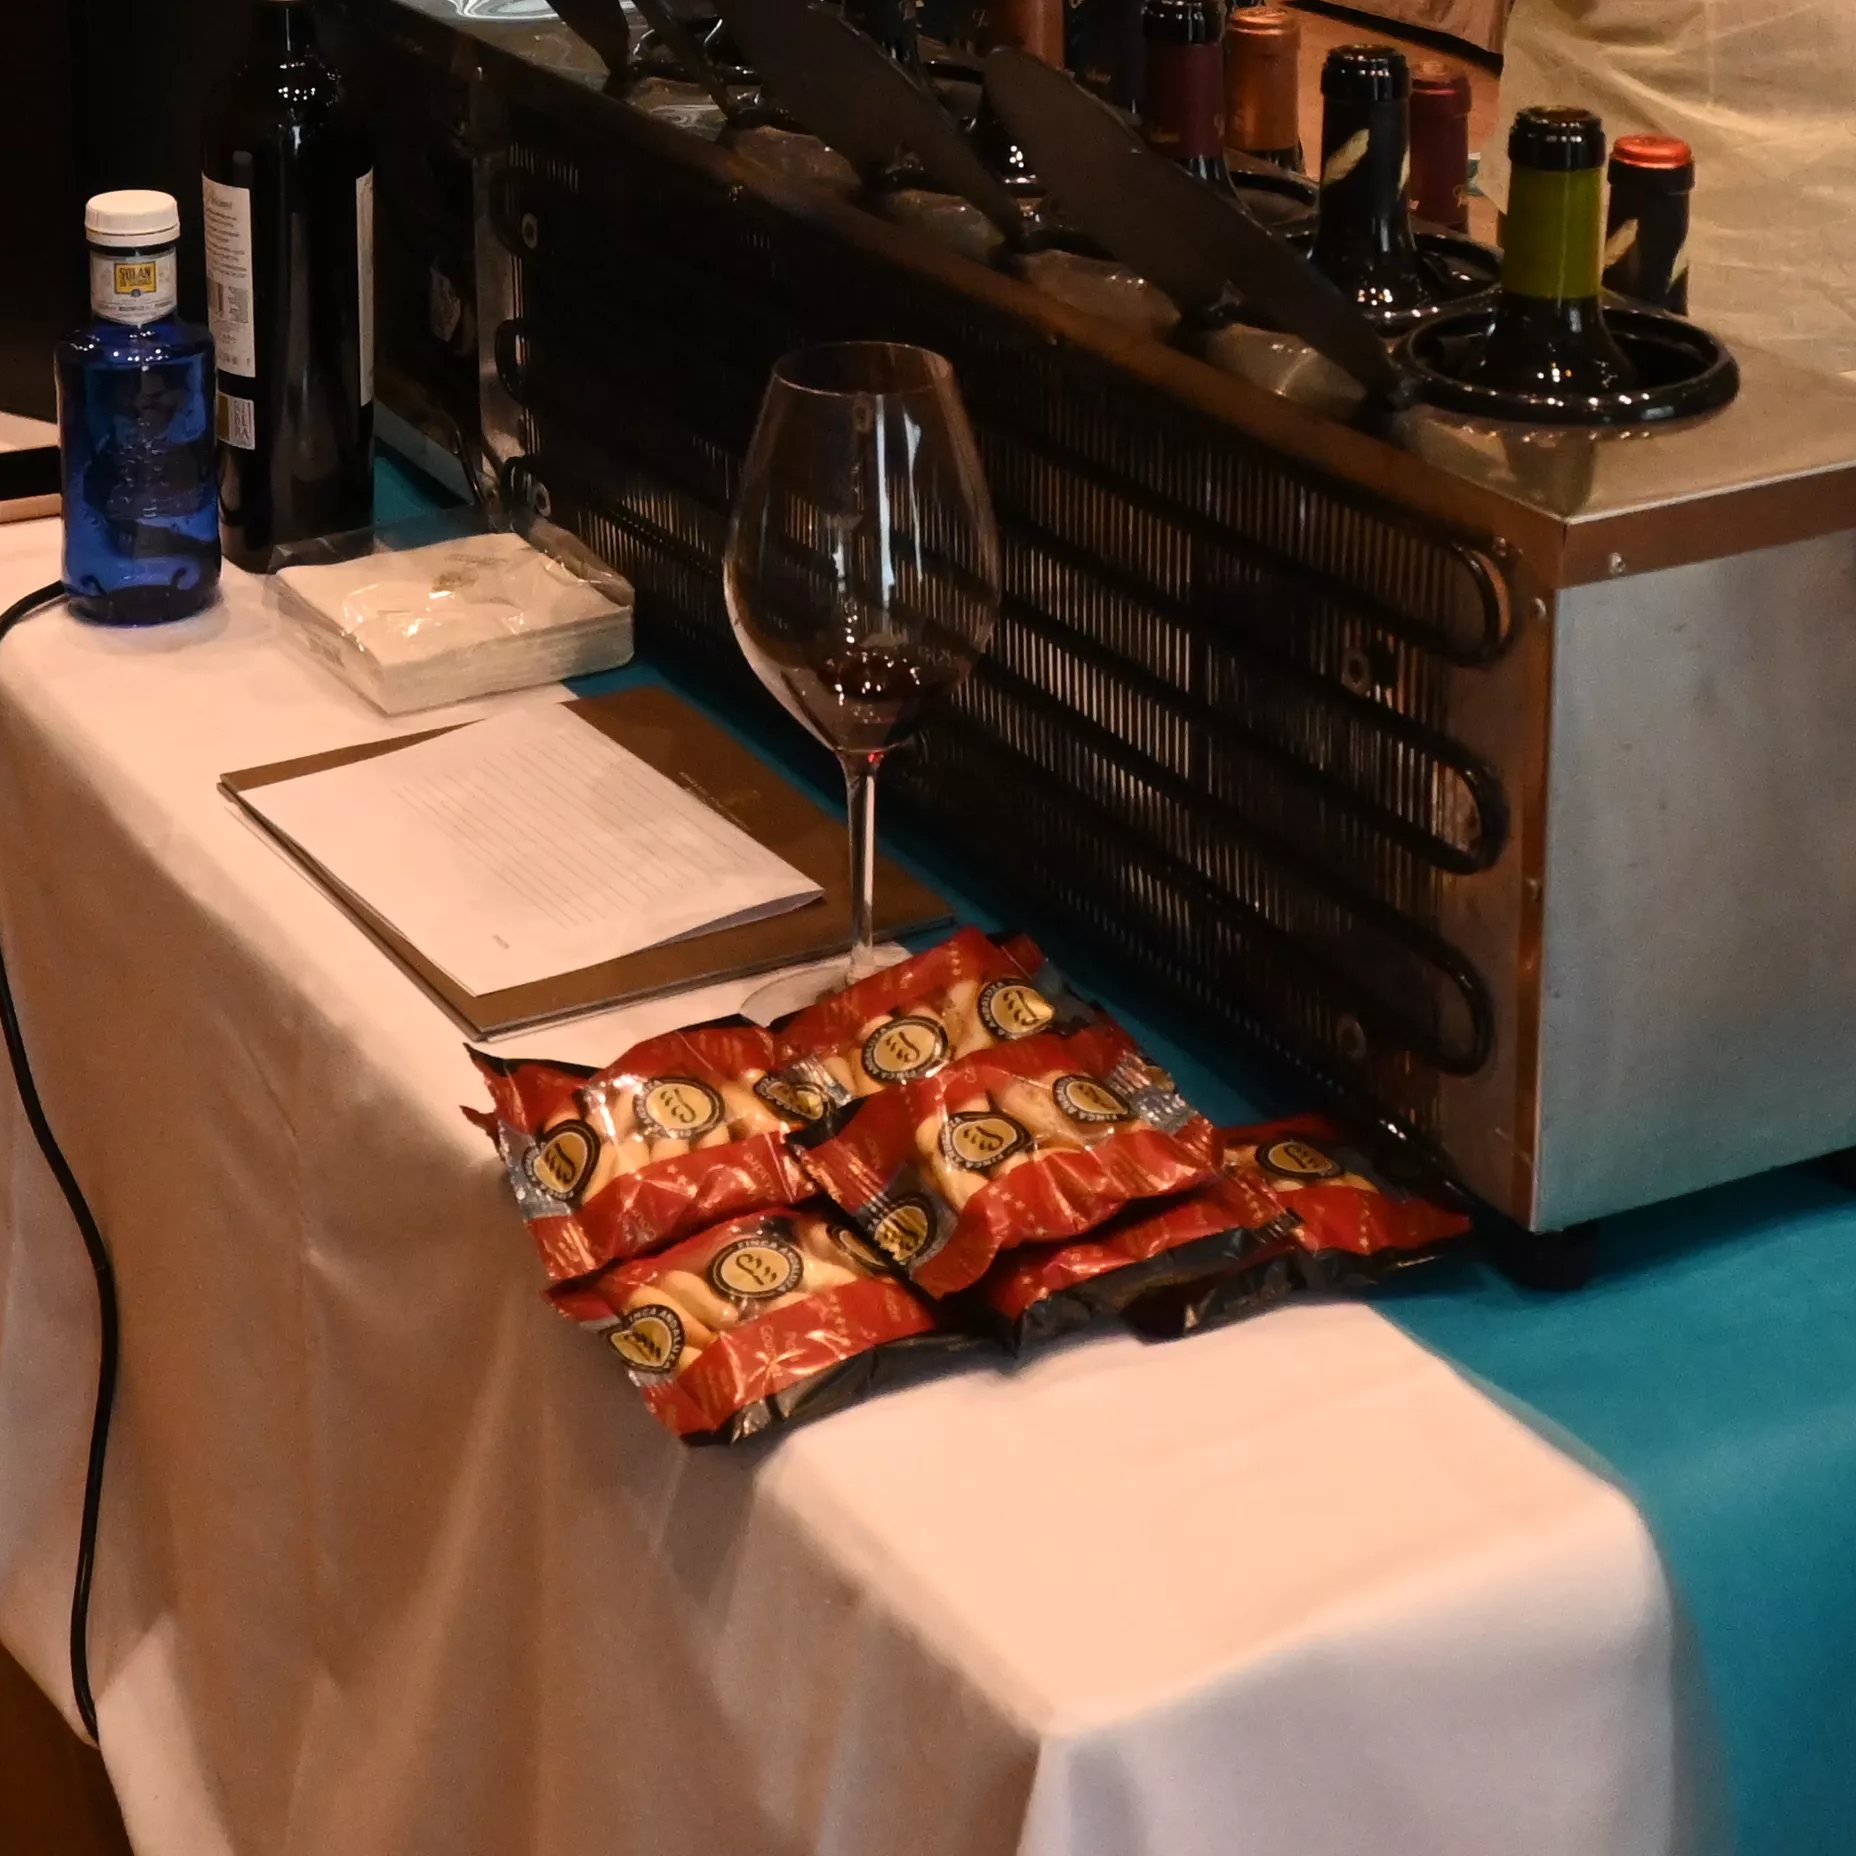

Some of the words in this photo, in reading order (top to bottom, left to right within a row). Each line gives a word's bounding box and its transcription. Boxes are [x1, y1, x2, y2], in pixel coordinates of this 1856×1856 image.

[737, 1240, 778, 1249] FINCA
[776, 1247, 801, 1292] ANDALUZA
[628, 1307, 657, 1322] INCA
[658, 1310, 682, 1369] ANDALUZA
